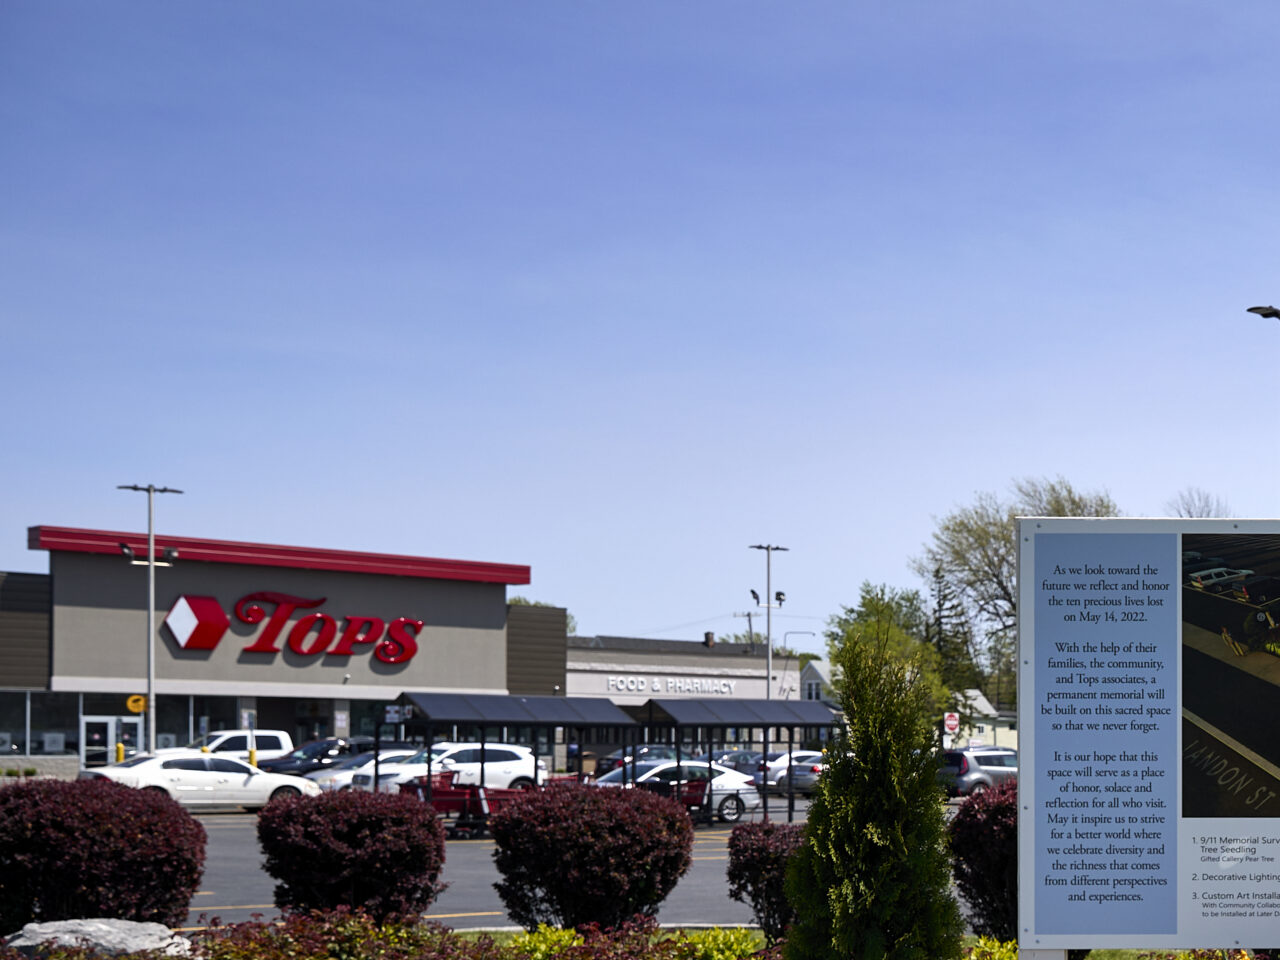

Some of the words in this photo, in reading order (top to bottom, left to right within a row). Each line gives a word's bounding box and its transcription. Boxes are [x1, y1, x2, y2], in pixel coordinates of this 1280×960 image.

[1053, 565, 1066, 574] As
[1084, 564, 1104, 575] look
[1108, 564, 1140, 575] toward
[1143, 564, 1158, 575] the
[1041, 580, 1071, 590] future
[1090, 580, 1118, 590] reflect
[1121, 580, 1140, 590] and
[1142, 580, 1170, 590] honor
[1048, 595, 1064, 606] the
[1084, 596, 1122, 609] precious
[1125, 595, 1144, 606] lives
[1147, 596, 1163, 606] lost
[1079, 611, 1102, 624] May
[1104, 611, 1118, 622] 14,
[1121, 612, 1148, 621] 2022.
[235, 592, 424, 664] TOPS
[1055, 642, 1079, 652] With
[1083, 642, 1098, 652] the
[1100, 642, 1120, 656] help
[1123, 642, 1133, 652] of
[1136, 642, 1157, 652] their
[1048, 658, 1087, 670] families,
[1090, 658, 1104, 668] the
[1107, 659, 1164, 671] community,
[608, 676, 647, 691] FOOD
[652, 678, 660, 692] &
[666, 679, 736, 694] PHARMACY
[1056, 673, 1073, 684] and
[1077, 673, 1099, 687] Tops
[1102, 674, 1148, 684] associates,
[1047, 692, 1097, 702] permanent
[1100, 688, 1144, 699] memorial
[1147, 689, 1165, 699] will
[1041, 704, 1053, 714] be
[1055, 704, 1077, 715] built
[1095, 704, 1112, 714] this
[1115, 704, 1143, 715] sacred
[1146, 708, 1171, 718] space
[1065, 720, 1084, 730] that
[1130, 720, 1160, 733] forget.
[1054, 751, 1062, 761] It
[1064, 752, 1072, 761] is
[1093, 751, 1117, 764] hope
[1119, 751, 1140, 761] that
[1141, 751, 1158, 761] this
[1047, 770, 1072, 780] space
[1074, 766, 1092, 776] will
[1142, 766, 1165, 780] place
[1060, 782, 1070, 792] of
[1072, 782, 1102, 793] honor,
[1104, 782, 1132, 792] solace
[1135, 782, 1152, 792] and
[1045, 797, 1088, 808] reflection
[1092, 797, 1106, 808] for
[1108, 797, 1120, 808] all
[1122, 797, 1143, 808] who
[1145, 798, 1166, 808] visit.
[1246, 786, 1276, 811] ST
[1048, 813, 1069, 826] May
[1072, 814, 1079, 824] it
[1081, 814, 1112, 827] inspire
[1140, 814, 1165, 823] strive
[1050, 828, 1064, 839] for
[1075, 828, 1102, 839] better
[1104, 828, 1131, 839] world
[1134, 828, 1162, 839] where
[1200, 837, 1216, 845] 9/11
[1063, 844, 1103, 855] celebrate
[1106, 844, 1144, 857] diversity
[1147, 844, 1165, 854] and
[1220, 846, 1256, 855] Seedling
[1052, 860, 1067, 870] the
[1070, 859, 1107, 870] richness
[1109, 859, 1128, 870] that
[1045, 875, 1067, 886] from
[1070, 875, 1110, 886] different
[1113, 876, 1168, 889] perspectives
[1068, 890, 1086, 901] and
[1089, 891, 1144, 904] experiences.
[1202, 892, 1234, 900] Custom
